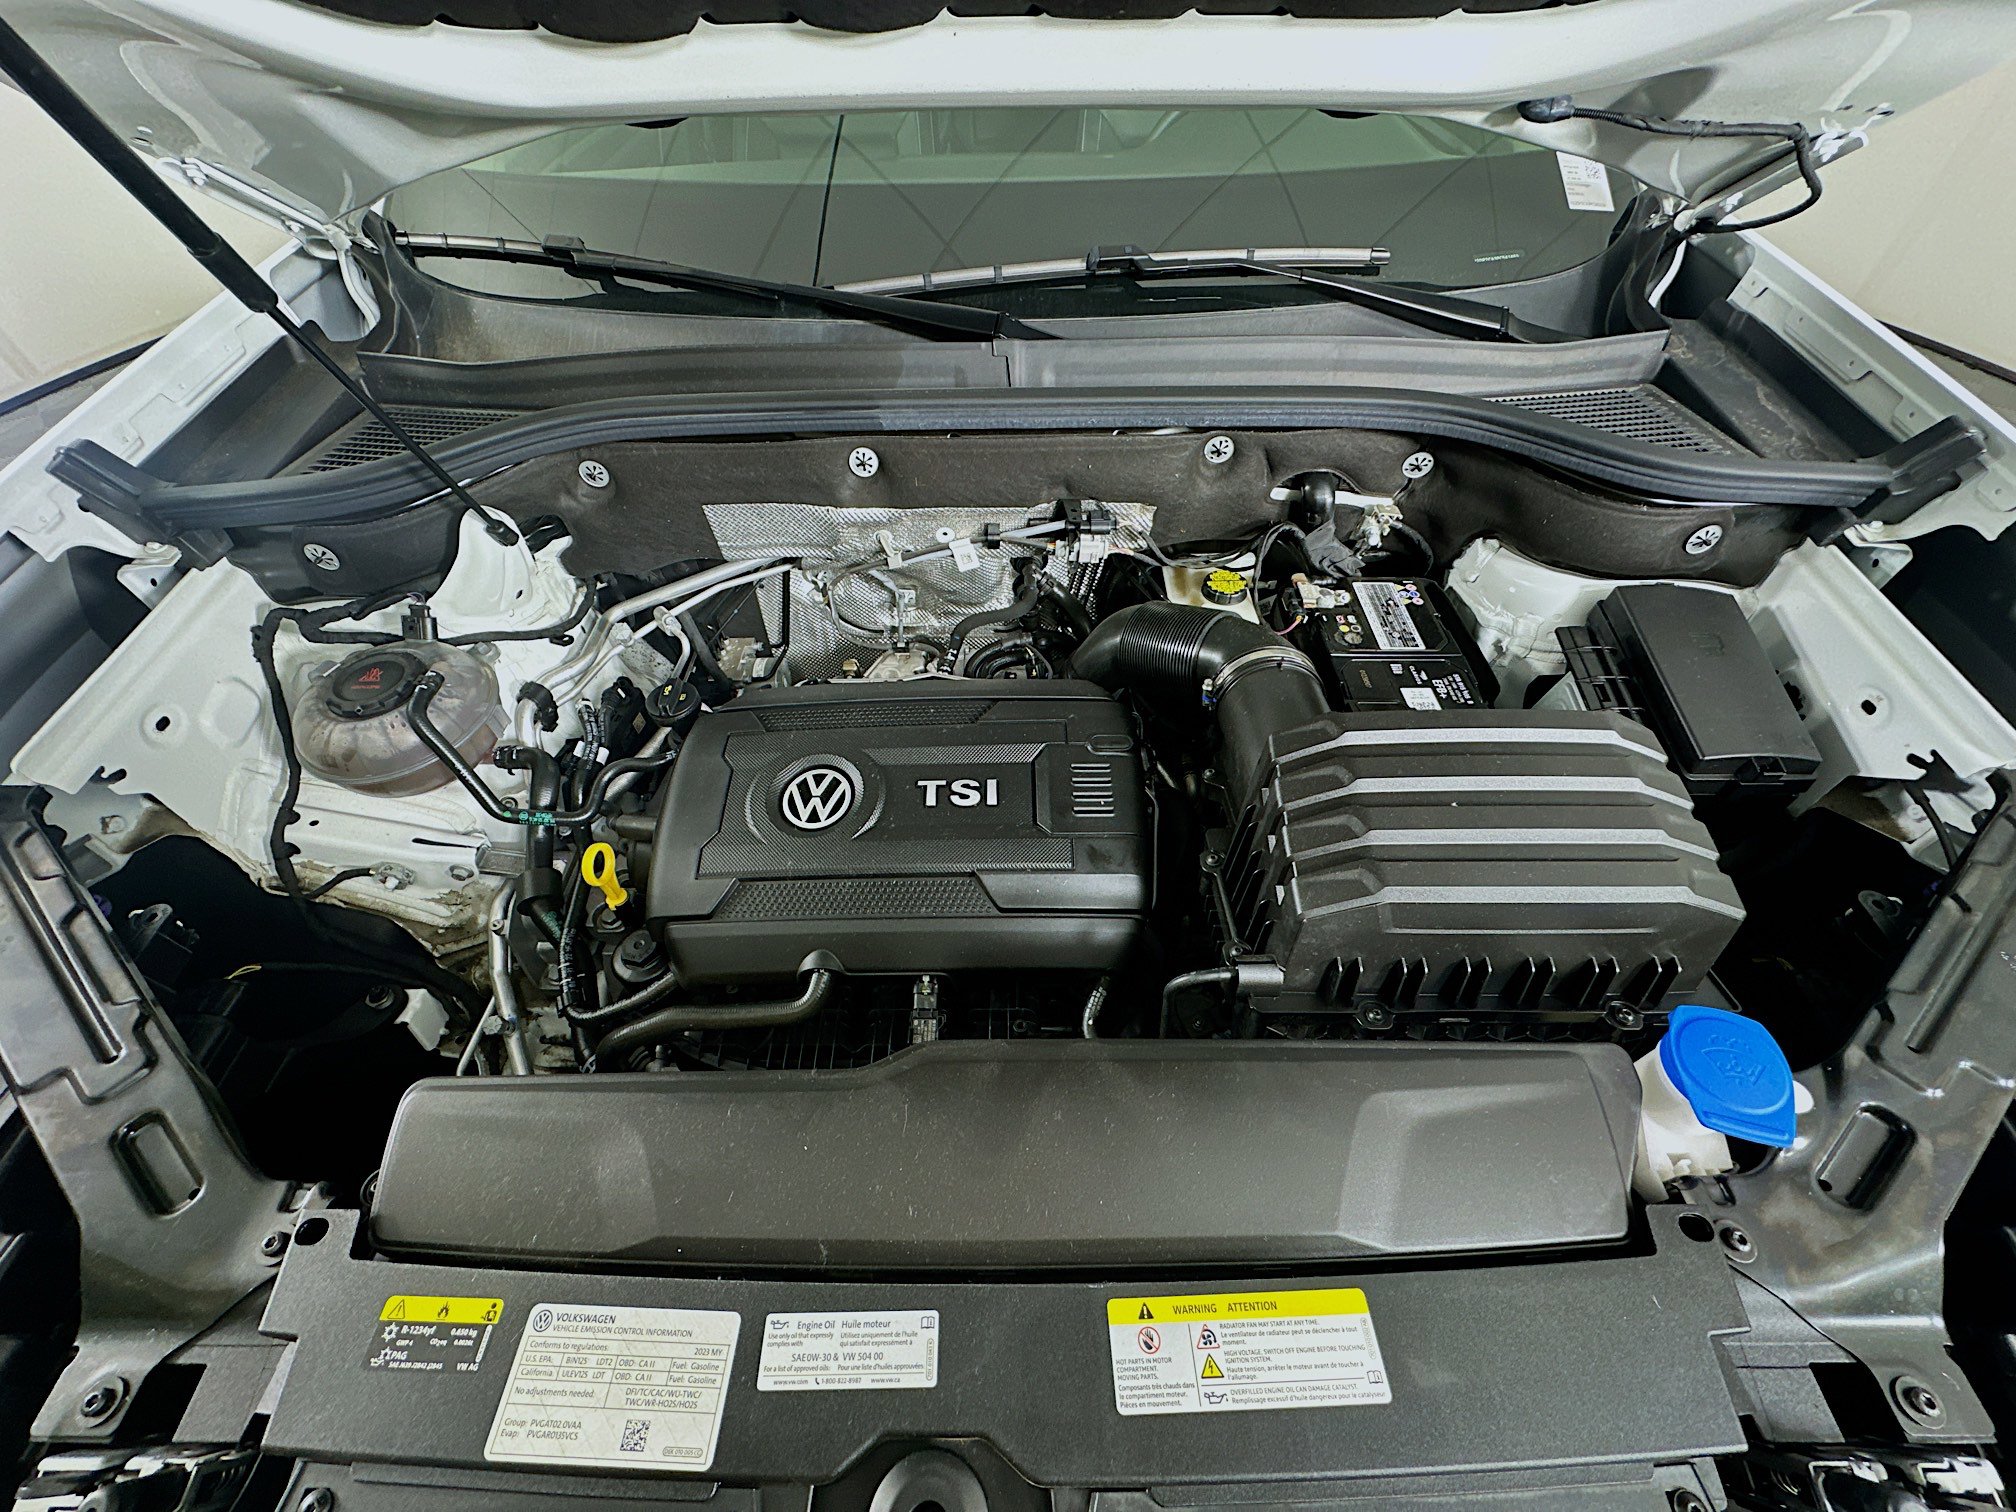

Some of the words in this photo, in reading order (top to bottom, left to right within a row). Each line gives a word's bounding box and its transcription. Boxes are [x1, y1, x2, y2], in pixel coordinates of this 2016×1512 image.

[1432, 680, 1447, 698] EFB+
[917, 778, 999, 807] TSI
[782, 768, 851, 829] VW
[1173, 1303, 1217, 1315] WARNING
[1227, 1301, 1278, 1313] ATTENTION
[556, 1313, 616, 1324] VOLKSWAGEN
[798, 1321, 823, 1331] Engine
[824, 1320, 835, 1329] Oil
[841, 1320, 862, 1328] Huile
[401, 1325, 436, 1337] R-1234yf
[581, 1326, 612, 1334] EMISSION
[614, 1327, 644, 1335] CONTROL
[646, 1329, 693, 1337] INFORMATION
[809, 1332, 834, 1340] expressly
[530, 1341, 561, 1349] Conforms
[391, 1351, 408, 1360] PAG
[695, 1347, 710, 1356] 2023
[711, 1349, 722, 1357] MY
[833, 1353, 839, 1361] &
[842, 1352, 856, 1361] VW
[858, 1352, 872, 1360] 504
[873, 1352, 884, 1360] 00
[596, 1358, 613, 1366] LDT2
[672, 1362, 687, 1370] Fuel:
[691, 1362, 720, 1371] Gasoline
[794, 1365, 818, 1373] approved
[561, 1370, 588, 1378] ULEV125
[669, 1375, 685, 1383] Fuel:
[688, 1376, 717, 1384] Gasoline
[526, 1387, 567, 1397] adjustments
[1119, 1384, 1150, 1392] Composants
[1309, 1394, 1337, 1402] dangereux
[500, 1429, 519, 1438] Evap:
